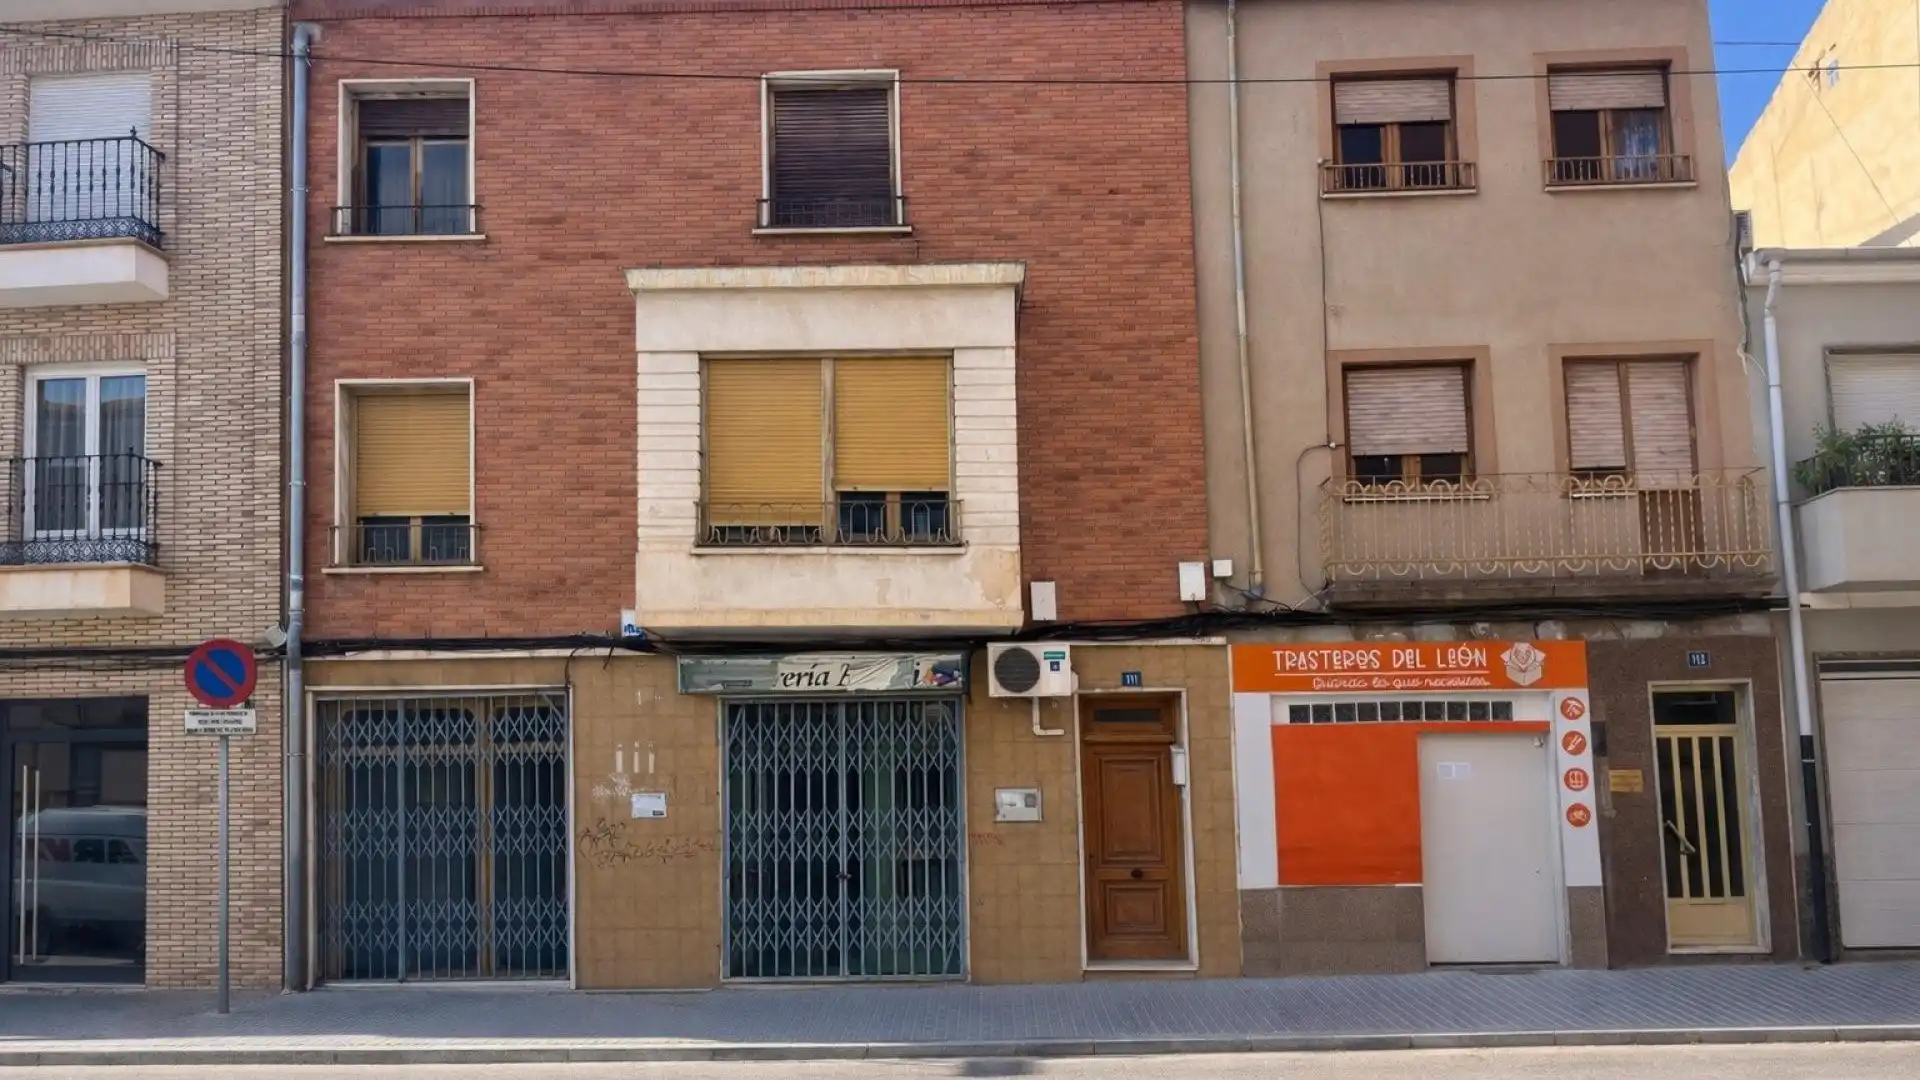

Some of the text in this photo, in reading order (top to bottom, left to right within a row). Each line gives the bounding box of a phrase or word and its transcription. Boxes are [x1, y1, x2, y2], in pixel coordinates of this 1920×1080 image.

[1272, 643, 1487, 670] TRASTEROS DEL LEÓN
